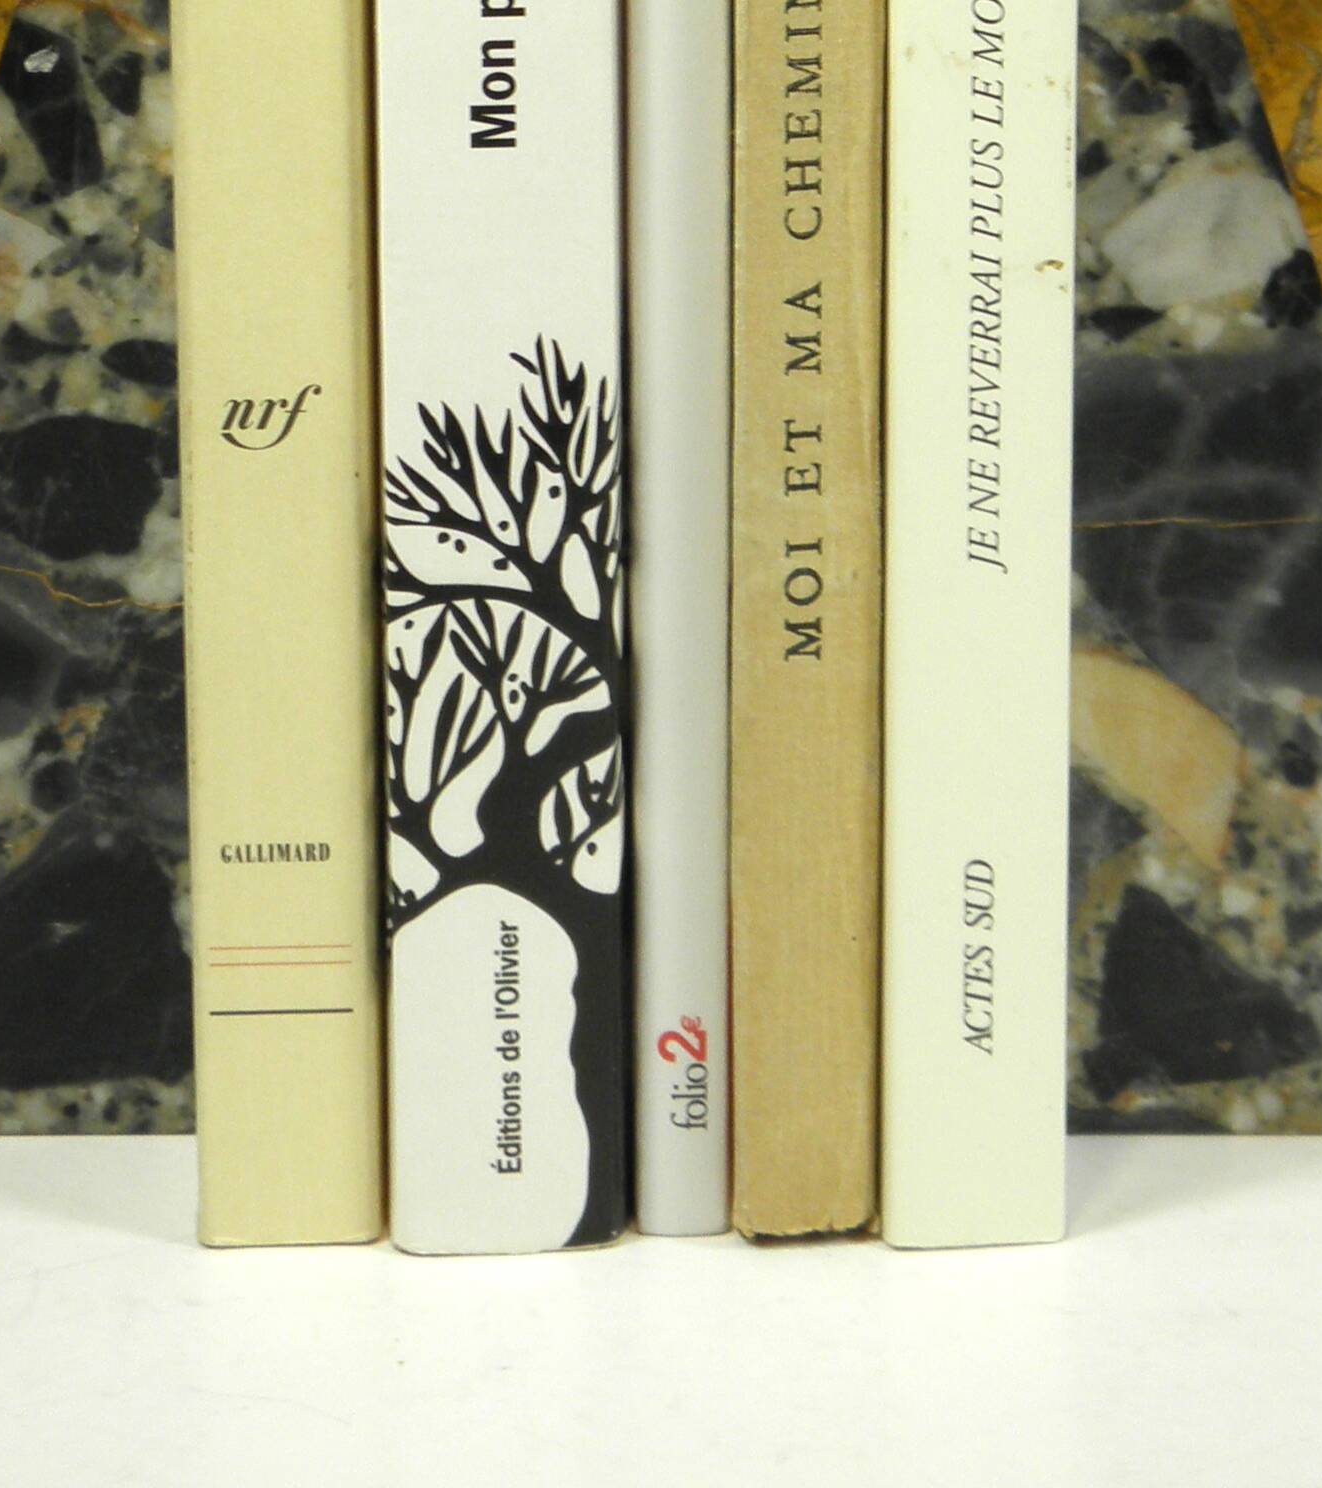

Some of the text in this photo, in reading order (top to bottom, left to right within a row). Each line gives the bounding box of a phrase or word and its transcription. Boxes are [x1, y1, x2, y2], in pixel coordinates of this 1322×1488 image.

[470, 40, 516, 148] Mon
[972, 77, 1003, 126] LE
[971, 139, 1002, 239] PLUS
[784, 282, 821, 375] MA
[970, 251, 1001, 447] REVERRAI
[222, 385, 321, 450] nrf
[784, 420, 821, 495] ET
[969, 459, 999, 517] NE
[969, 527, 1008, 573] JE
[784, 539, 823, 660] MOI
[221, 843, 330, 863] GALLIMARD
[964, 860, 993, 1054] ACTES SUD
[491, 921, 521, 1173] Éditions de l'Olivier
